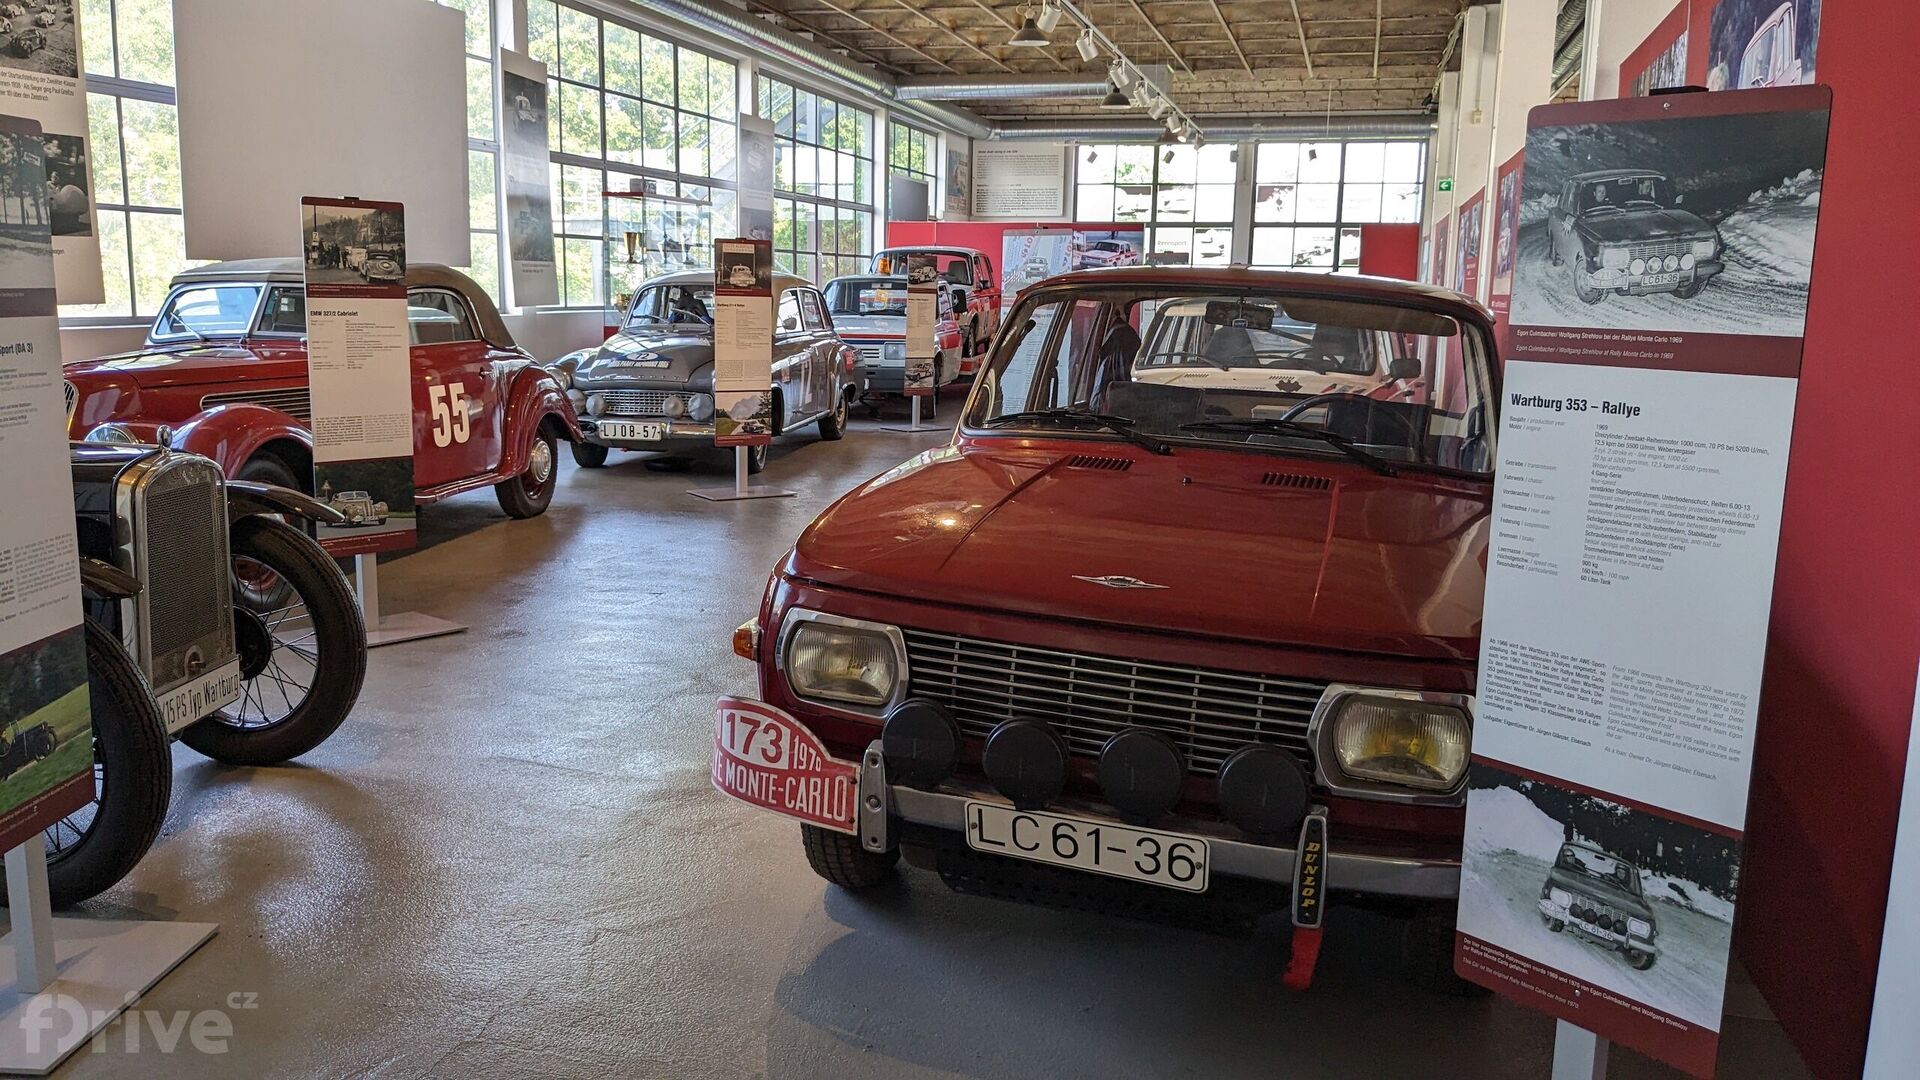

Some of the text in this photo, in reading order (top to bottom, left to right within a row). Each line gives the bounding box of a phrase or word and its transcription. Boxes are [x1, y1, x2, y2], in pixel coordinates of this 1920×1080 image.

[429, 382, 470, 447] 55
[1509, 393, 1642, 418] Wartburg 353 Rallye
[177, 693, 187, 720] PS
[188, 689, 202, 719] Typ
[203, 674, 239, 706] Wartburg
[726, 712, 783, 764] 173
[793, 735, 822, 772] 1970
[726, 757, 848, 822] MONTE-CARLO
[1301, 842, 1320, 908] DUNLOP
